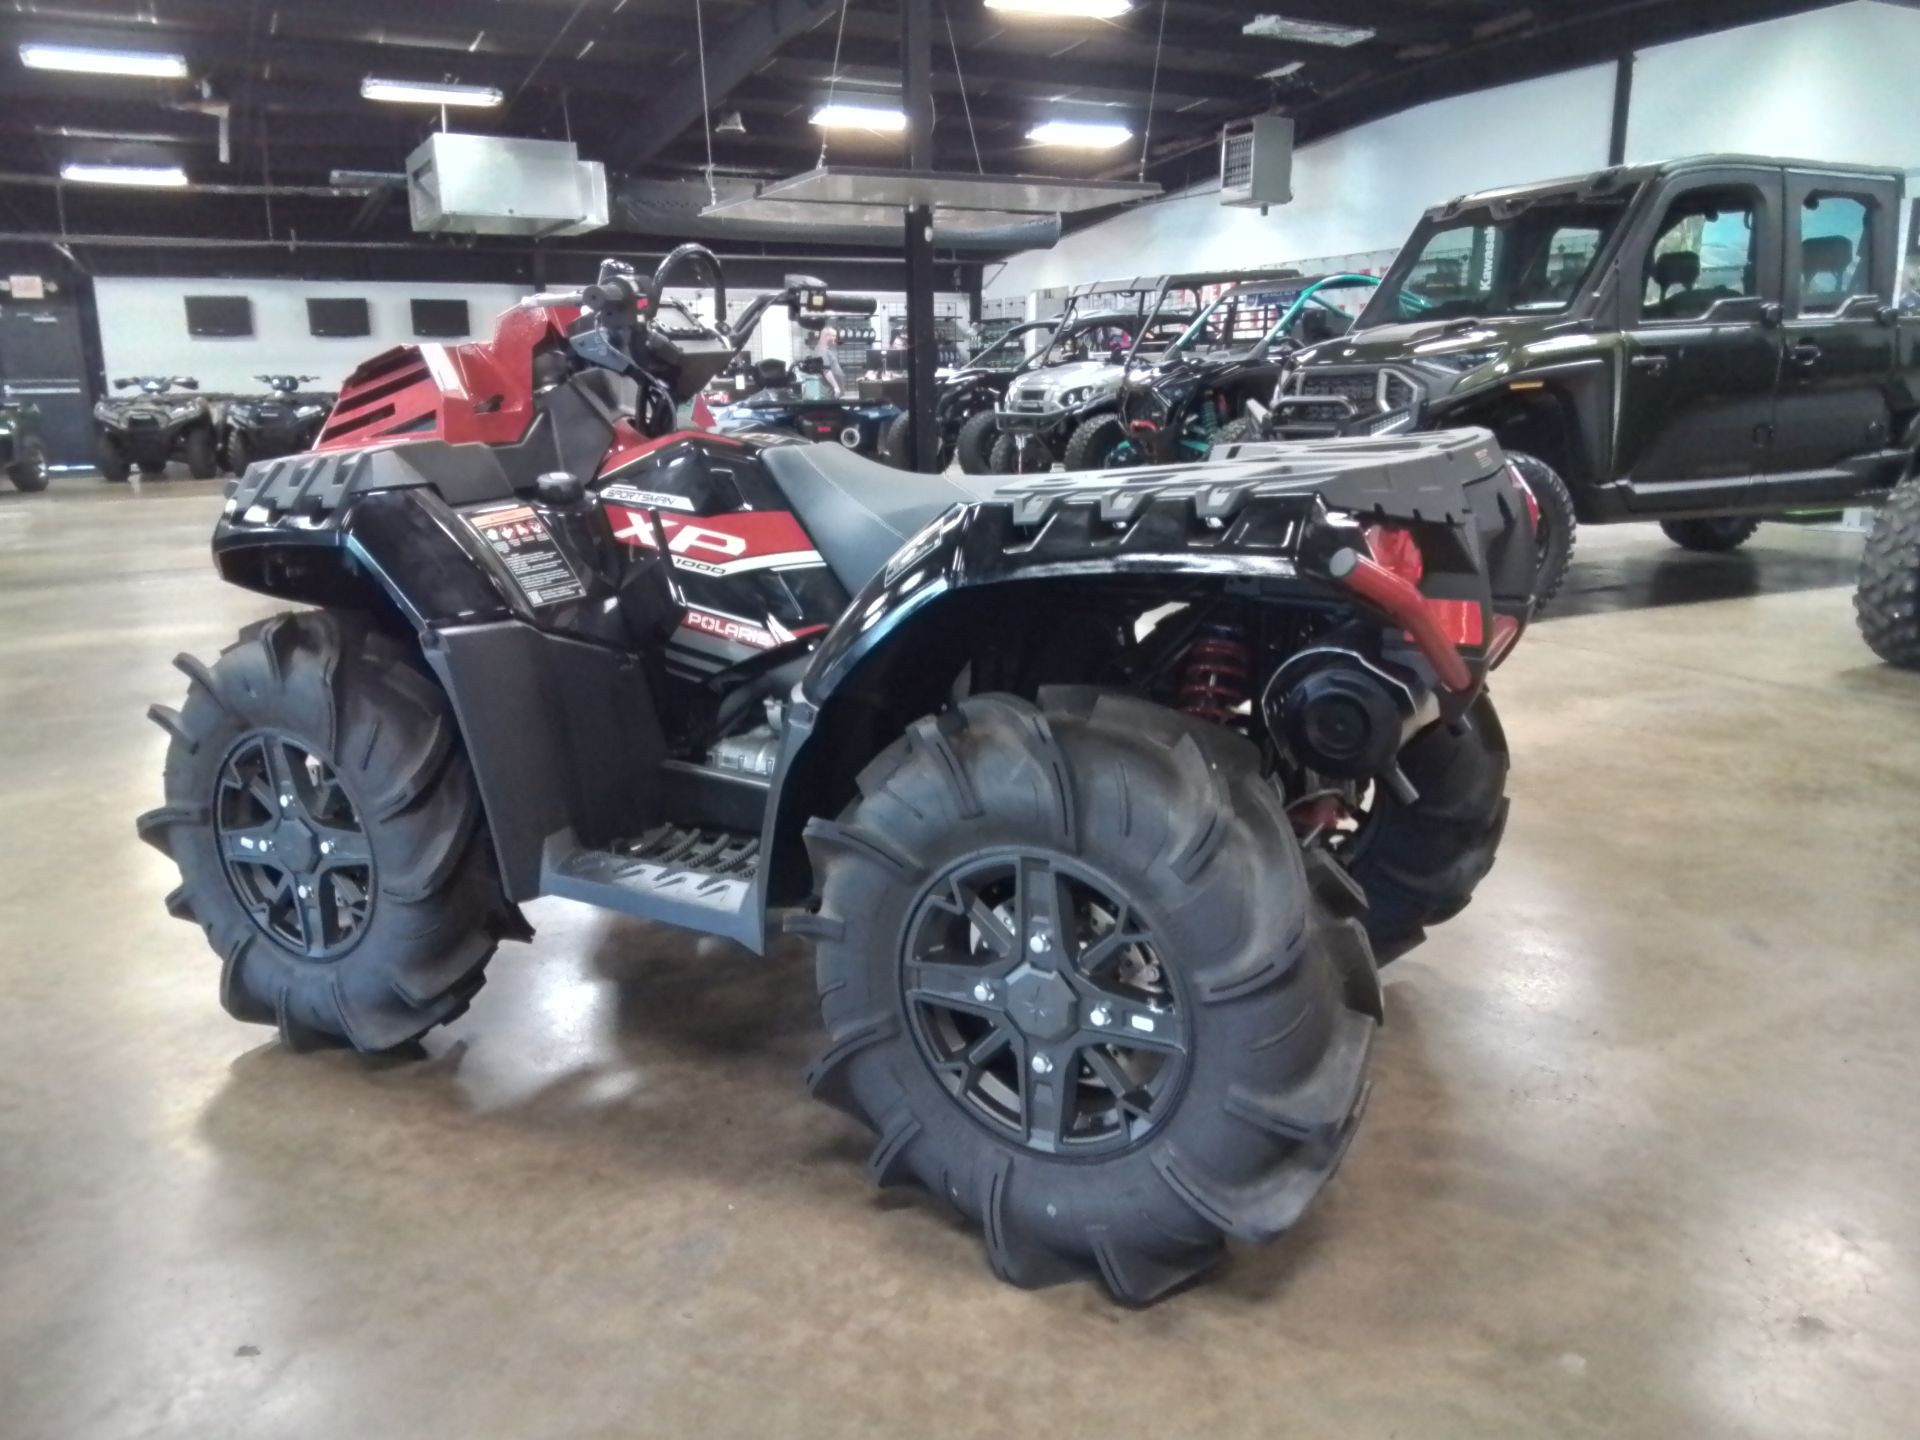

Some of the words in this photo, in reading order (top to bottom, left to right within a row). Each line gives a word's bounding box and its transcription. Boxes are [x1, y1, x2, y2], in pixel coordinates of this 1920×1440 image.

[1480, 226, 1496, 291] Kawasak
[606, 489, 676, 506] SPORTSMAN
[613, 511, 746, 556] XP
[675, 558, 727, 576] 1000
[687, 612, 776, 648] POLARIS
